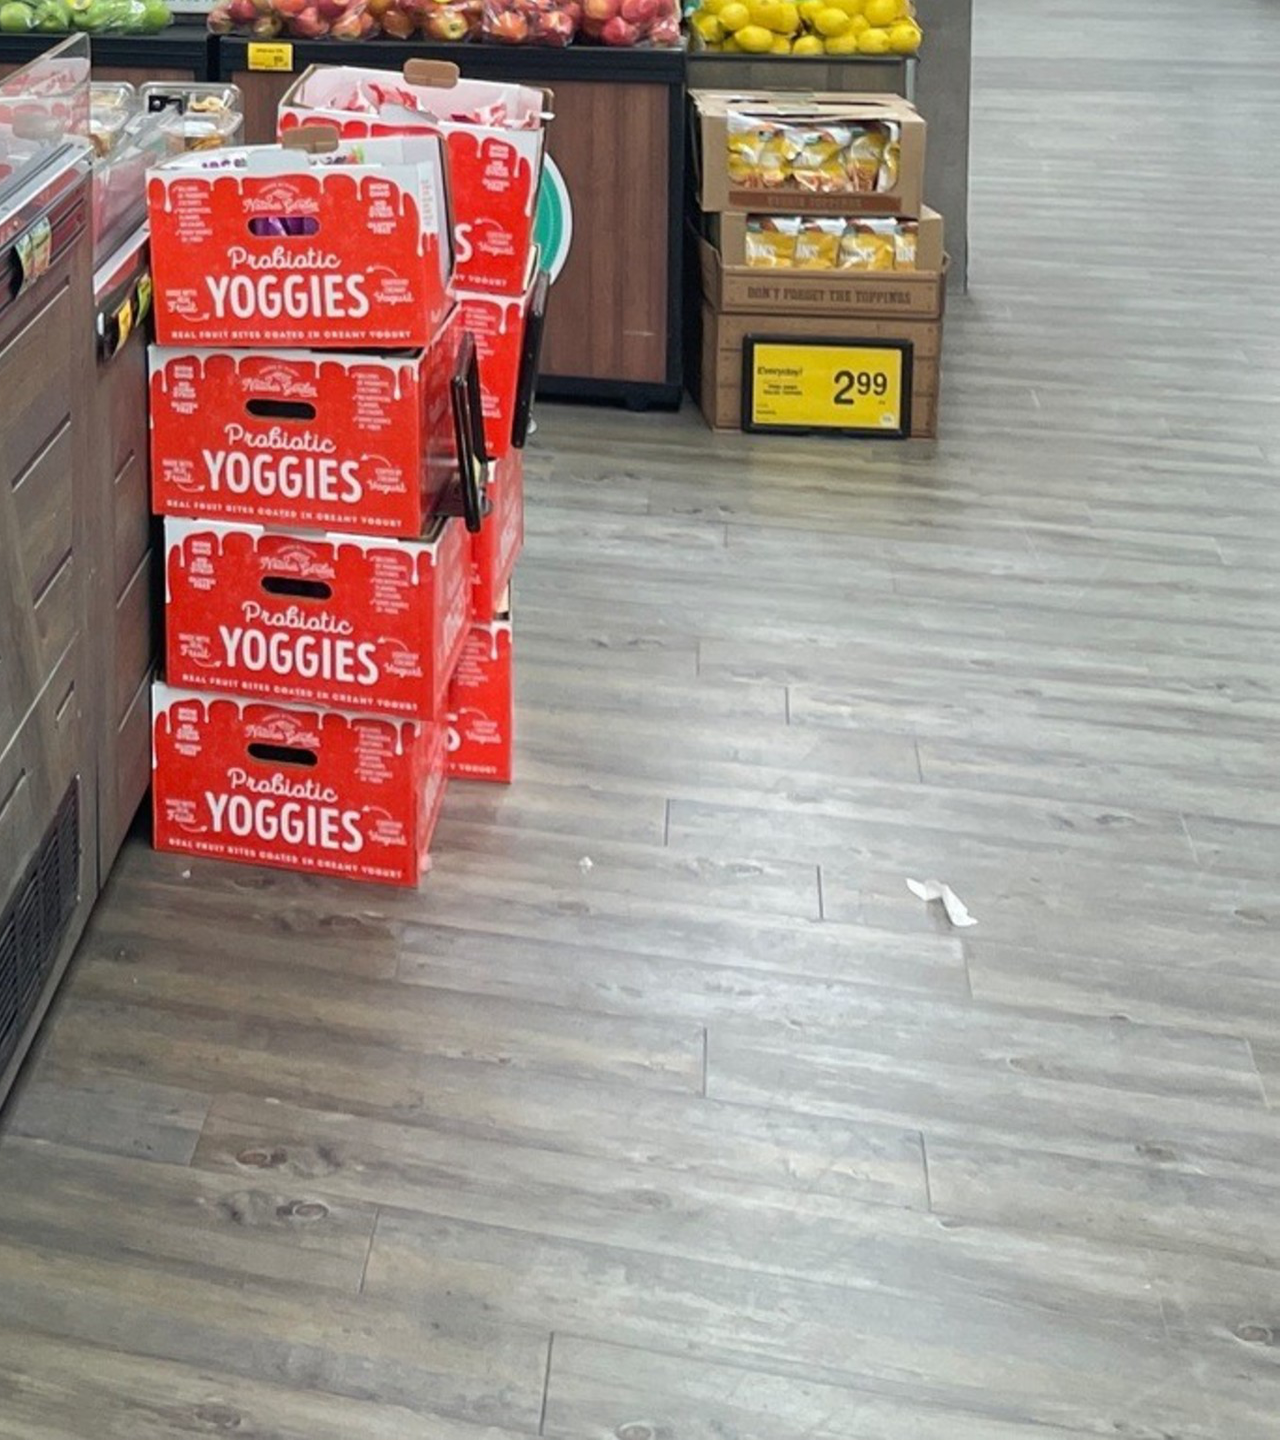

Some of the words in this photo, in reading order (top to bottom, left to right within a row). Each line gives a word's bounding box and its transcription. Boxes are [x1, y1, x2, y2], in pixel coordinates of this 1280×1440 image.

[228, 246, 341, 270] Probiotic
[206, 274, 370, 318] YOGGIES
[171, 330, 196, 340] REAL
[199, 330, 228, 340] FRUIT
[265, 330, 305, 340] COATED
[370, 330, 411, 340] YOGURT
[224, 423, 336, 453] Probiotic
[202, 449, 363, 503] YOGGIES
[166, 499, 191, 509] REAL
[194, 501, 222, 512] FRUIT
[258, 506, 297, 519] COATED
[361, 515, 403, 528] YOGURT
[242, 601, 353, 635] Probiotic
[219, 625, 379, 685] YOGGIES
[182, 674, 207, 684] REAL
[210, 676, 238, 688] FRUIT
[274, 684, 313, 698] COATED
[377, 697, 418, 711] YOGURT
[227, 767, 338, 802] Probiotic
[204, 791, 363, 853] YOGGIES
[169, 837, 193, 848] REAL
[196, 841, 224, 852] FRUIT
[259, 850, 298, 865] COATED
[361, 864, 402, 879] YOGURT
